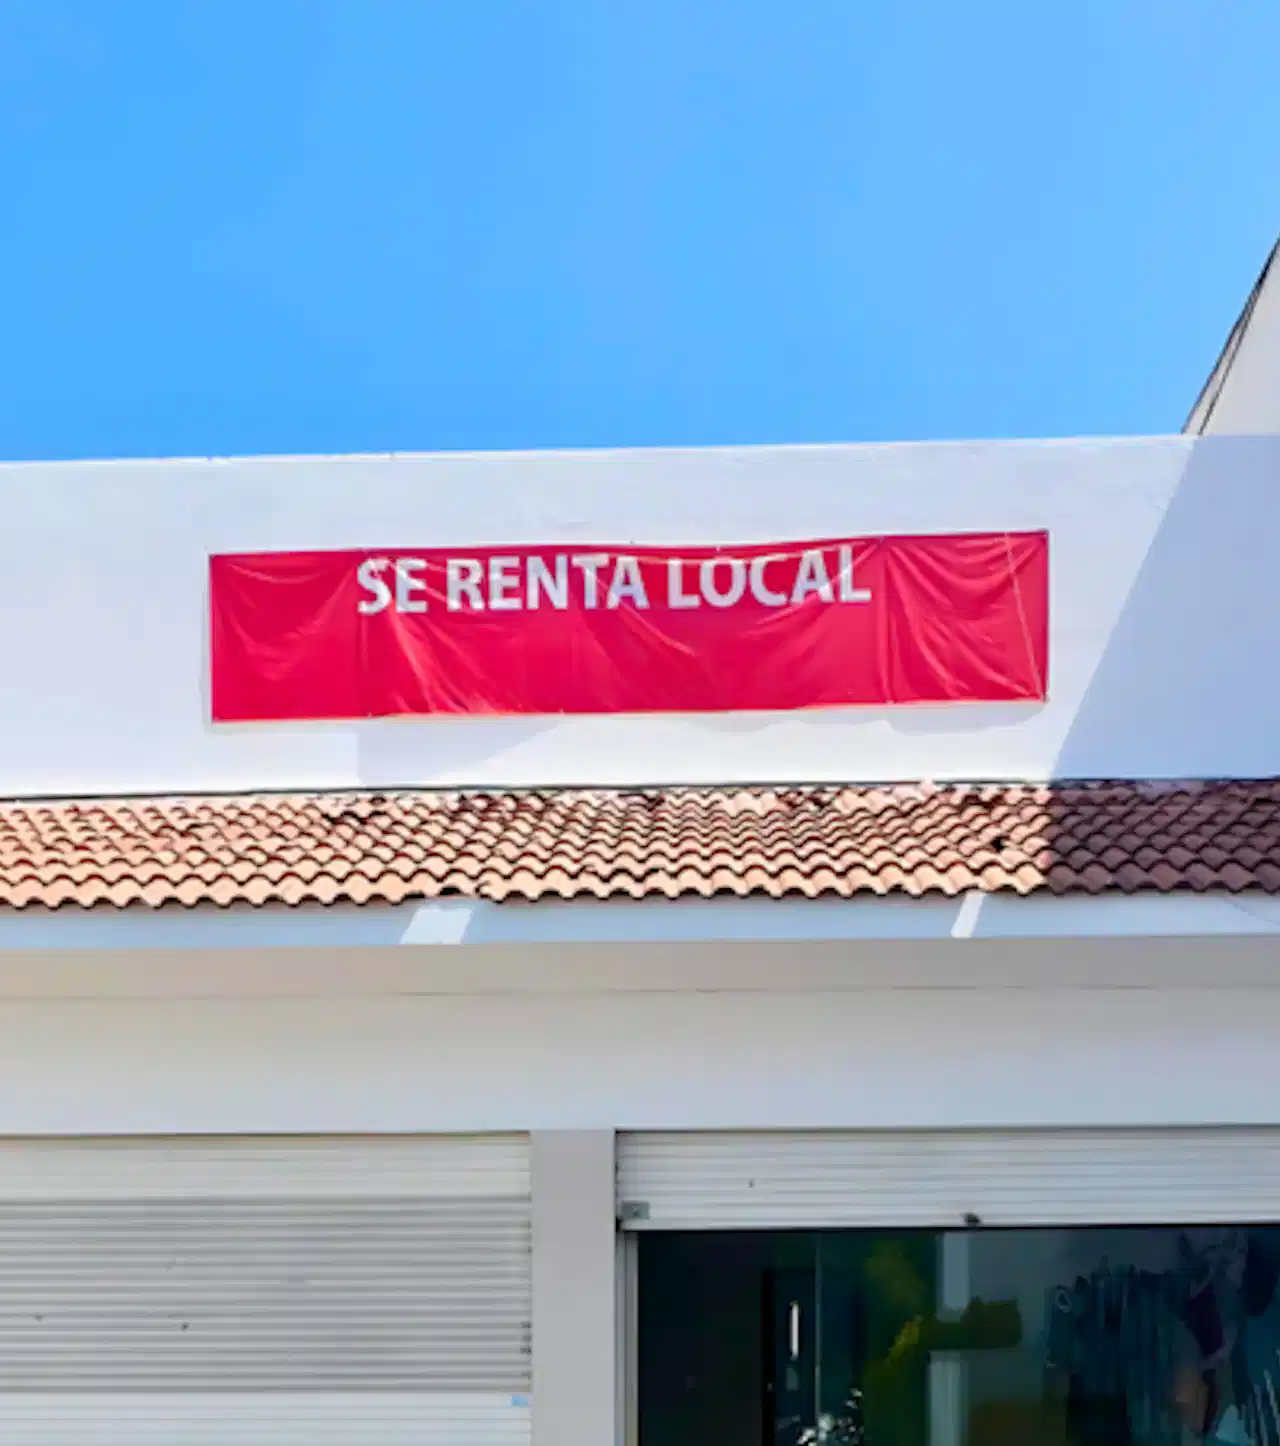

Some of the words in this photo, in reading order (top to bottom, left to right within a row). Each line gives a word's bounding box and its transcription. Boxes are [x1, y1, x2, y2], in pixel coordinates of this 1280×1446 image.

[356, 555, 429, 613] SE
[445, 552, 650, 611] RENTA
[666, 544, 872, 609] LOCAL
